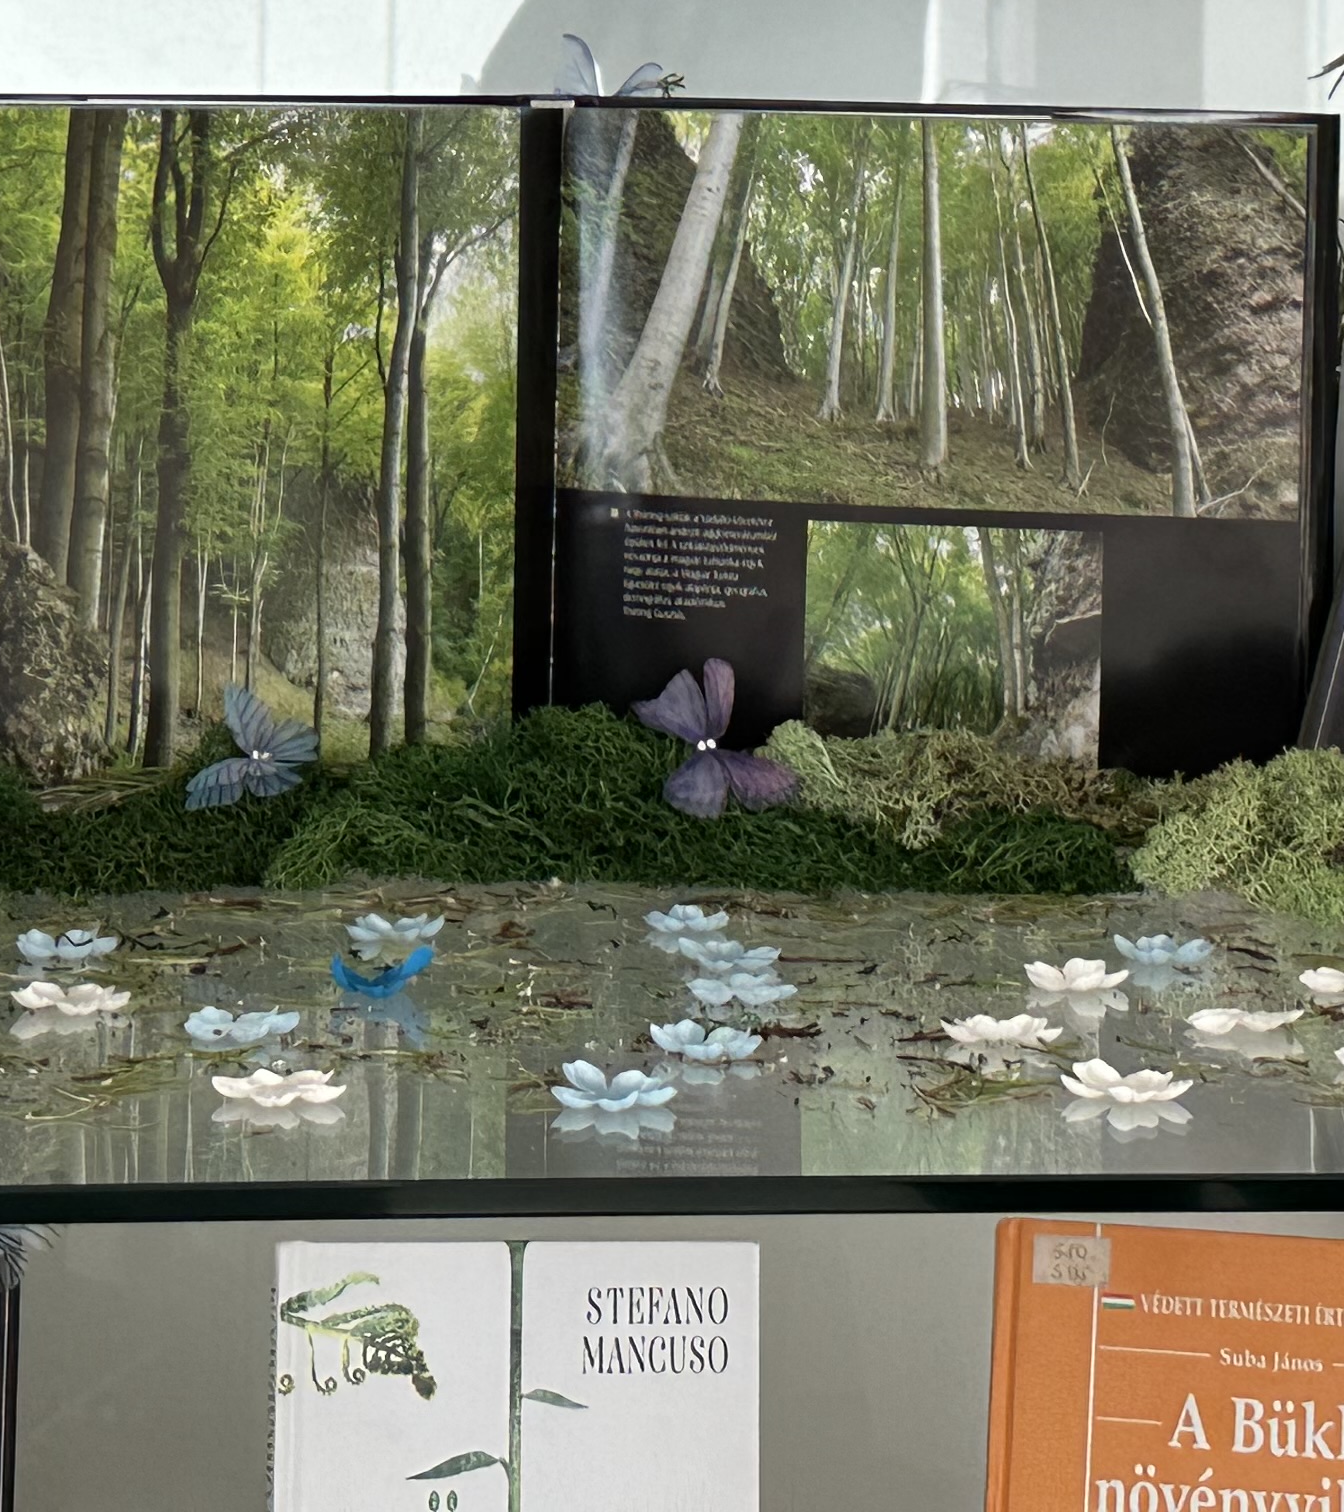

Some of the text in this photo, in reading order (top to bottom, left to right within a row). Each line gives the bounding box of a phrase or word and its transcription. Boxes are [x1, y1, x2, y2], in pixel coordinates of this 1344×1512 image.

[586, 1286, 730, 1326] STEFANO
[1140, 1289, 1203, 1317] VÉDETT
[1210, 1297, 1310, 1326] TERMÉSZETI
[581, 1335, 730, 1375] MANCUSO
[1219, 1347, 1325, 1373] Suba János
[1167, 1392, 1212, 1452] A
